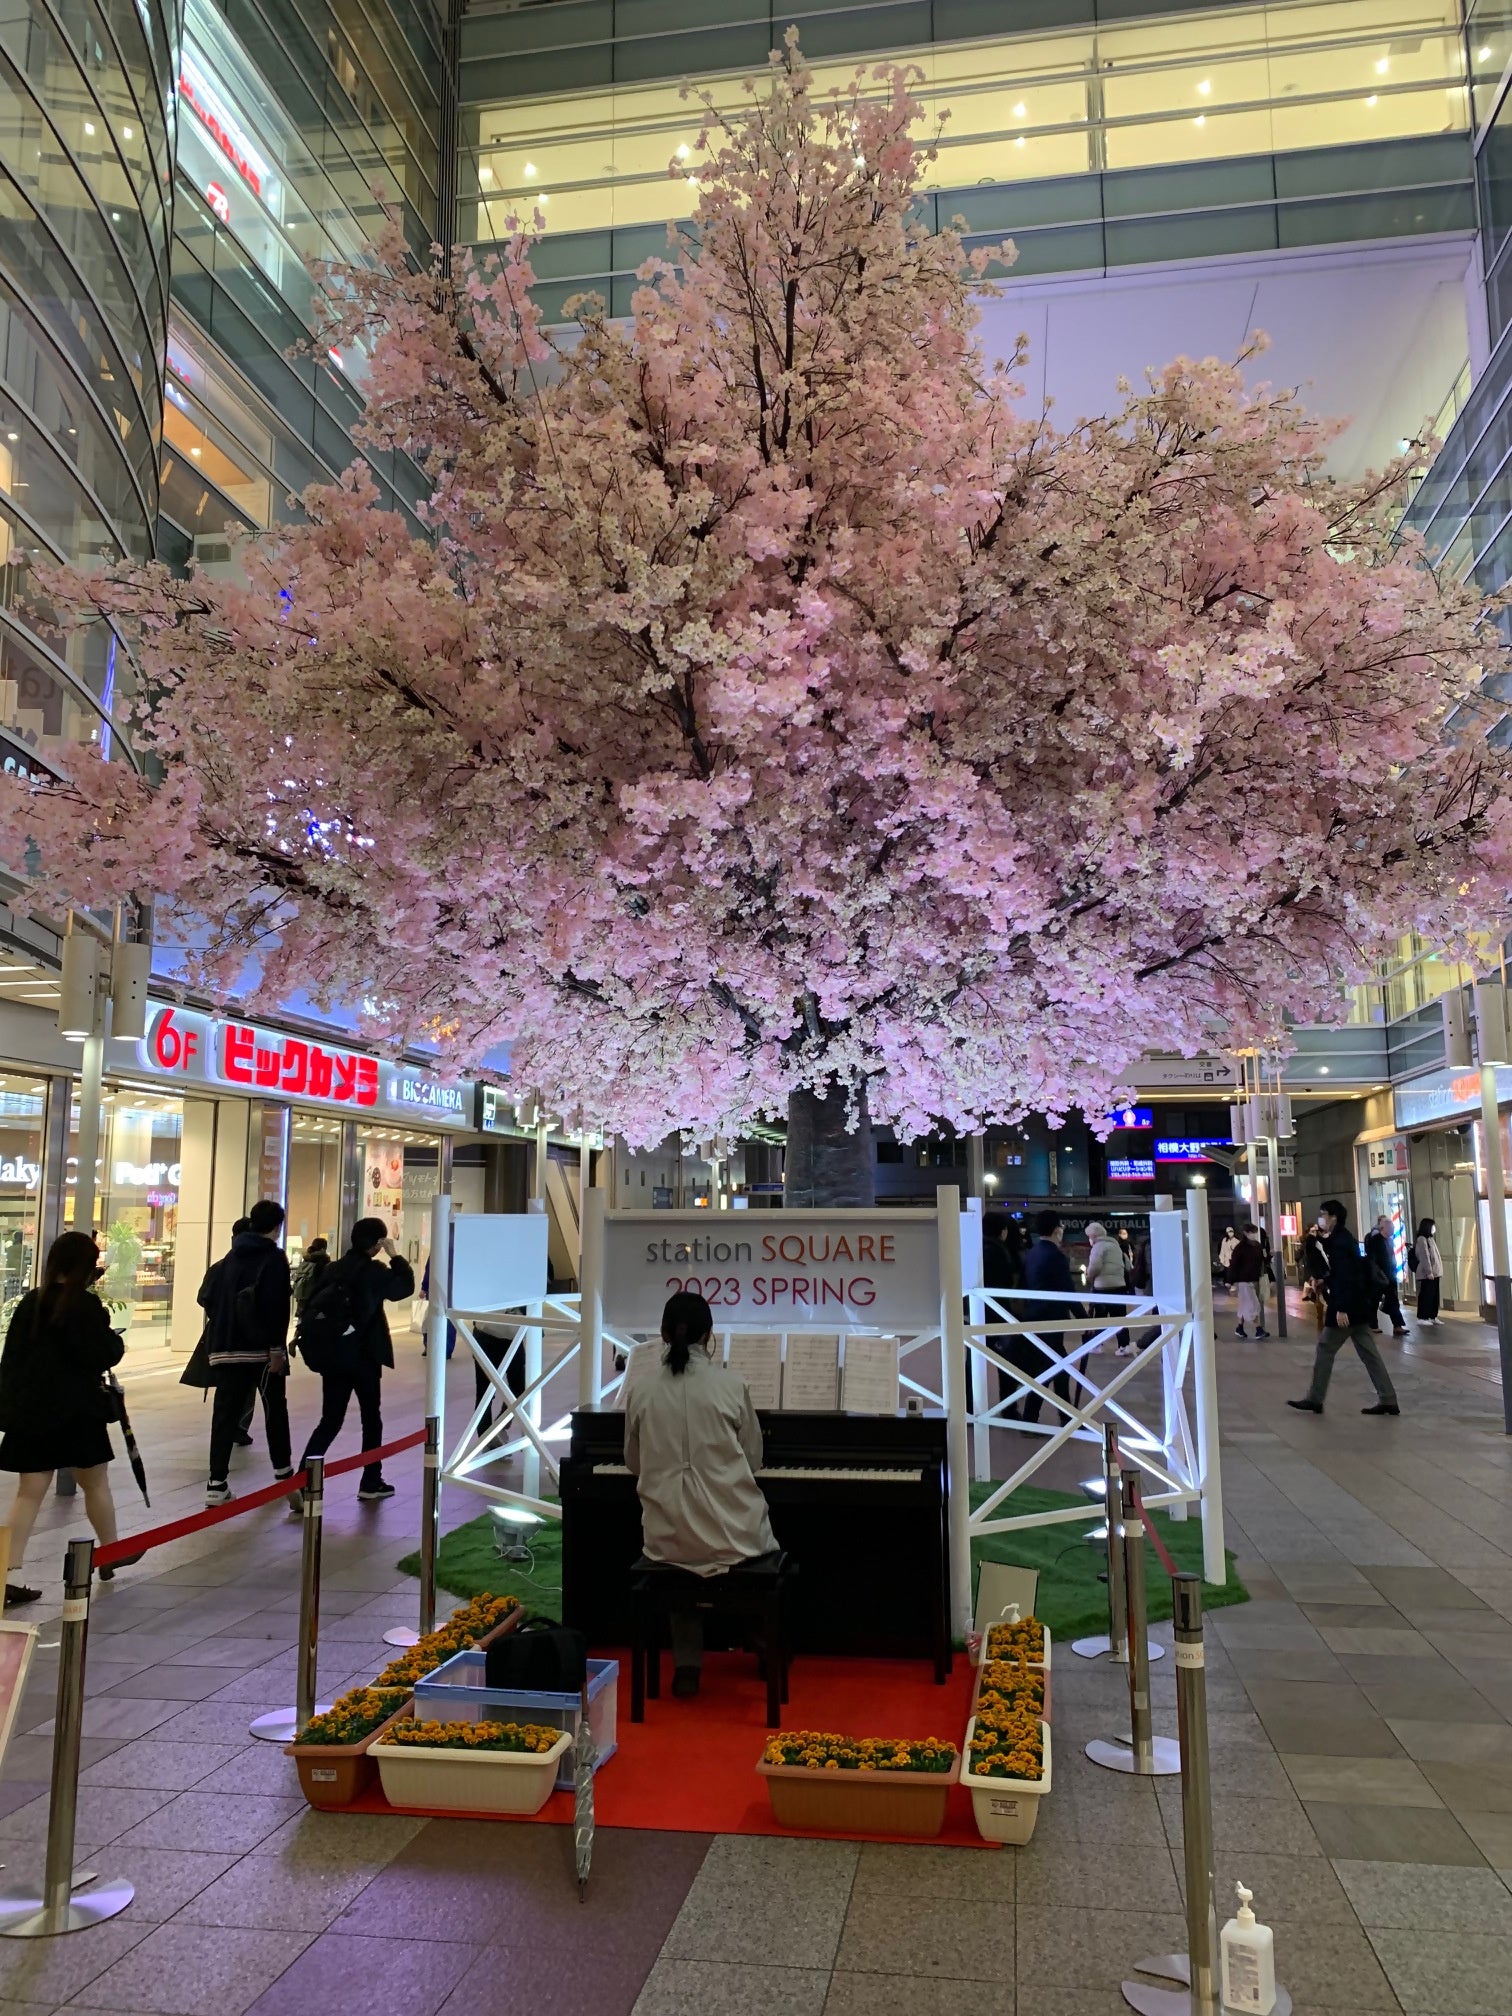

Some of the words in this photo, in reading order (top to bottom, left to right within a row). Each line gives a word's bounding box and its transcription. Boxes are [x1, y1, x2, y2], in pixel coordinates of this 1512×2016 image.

[156, 1008, 197, 1070] 6F
[224, 1023, 379, 1107] ビックカメラ
[645, 1235, 752, 1264] station
[761, 1234, 896, 1266] SQUARE
[665, 1276, 741, 1306] 2023
[752, 1276, 877, 1307] SPRING
